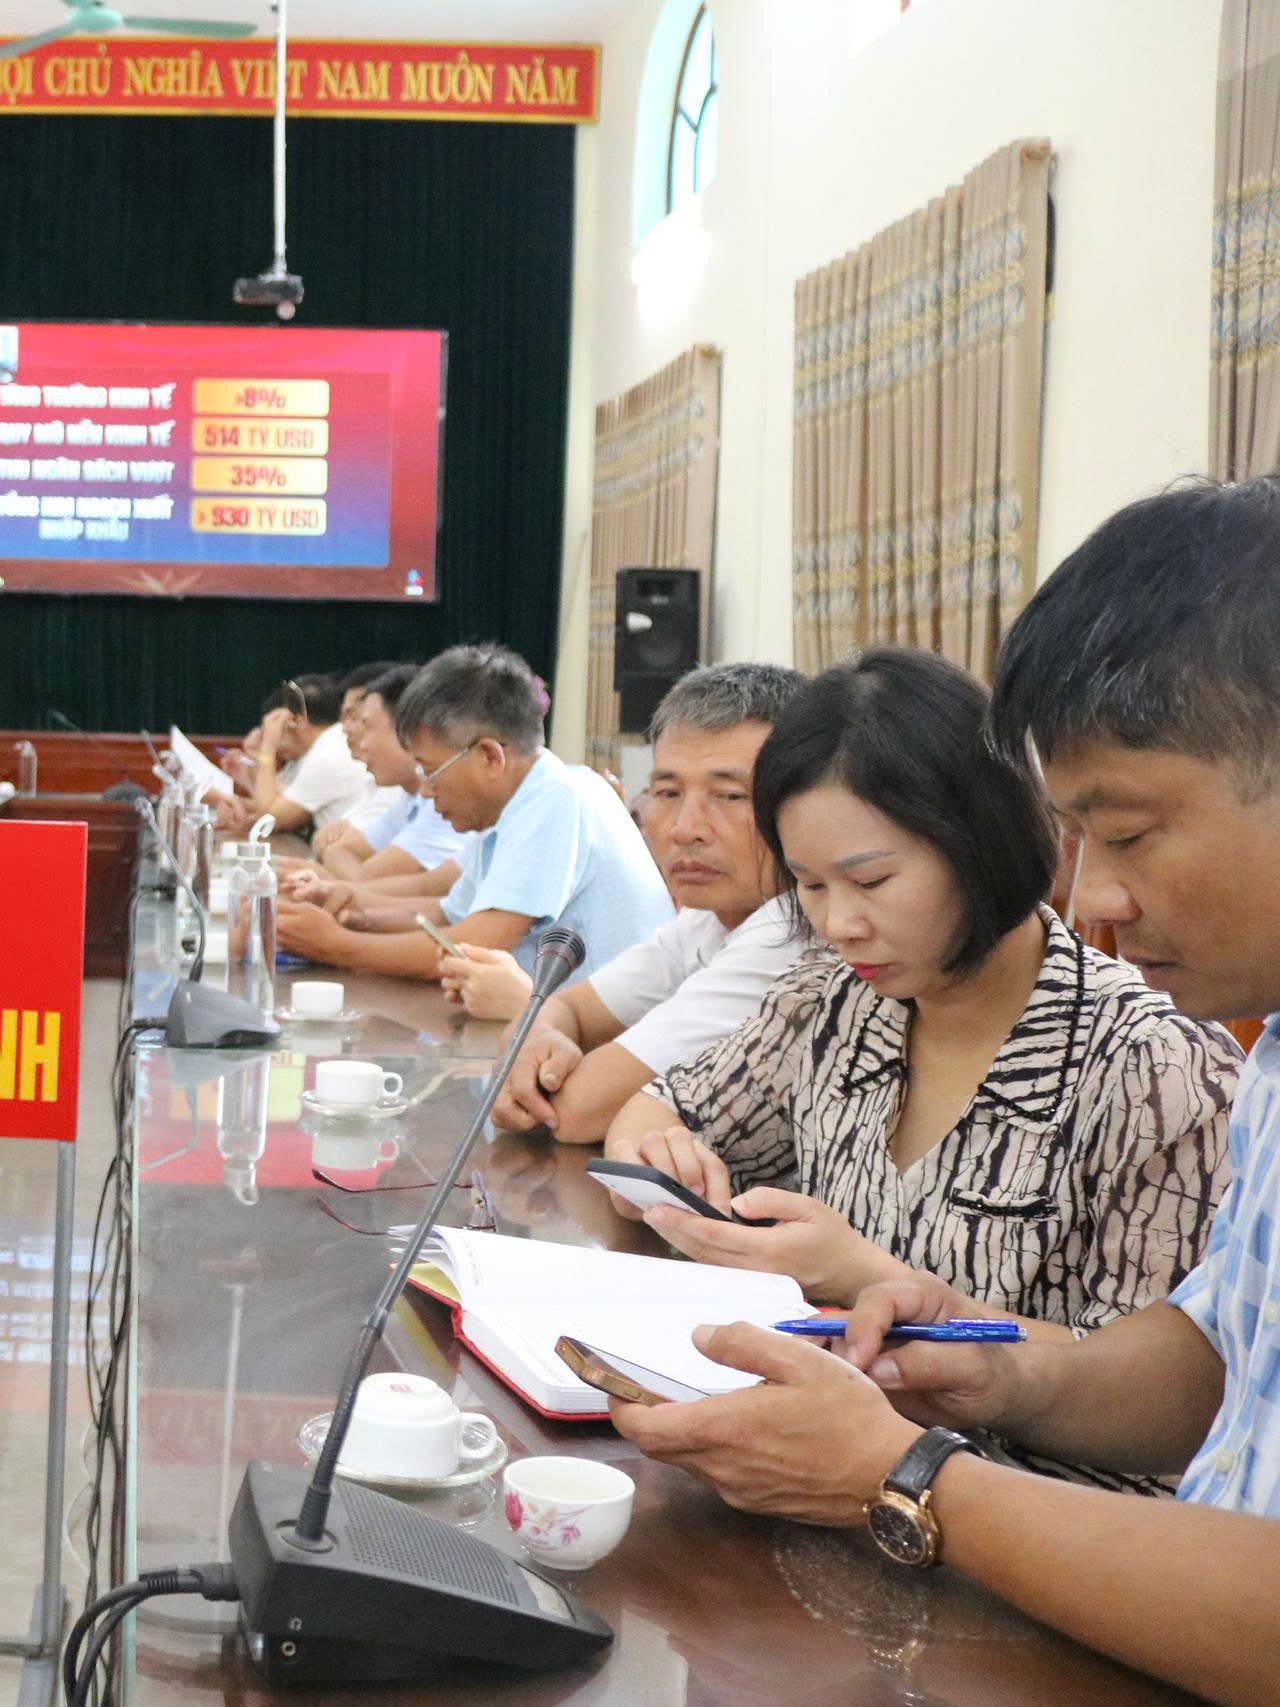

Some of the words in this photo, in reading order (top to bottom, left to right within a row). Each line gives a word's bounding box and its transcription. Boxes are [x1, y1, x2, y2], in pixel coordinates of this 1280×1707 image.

[43, 43, 111, 97] CHỦ
[316, 59, 392, 102] NAM
[402, 52, 495, 105] MUÔN
[504, 57, 579, 106] NĂM
[204, 425, 240, 447] 514
[275, 426, 316, 449] USD
[230, 464, 287, 487] 35%
[282, 507, 319, 529] USD
